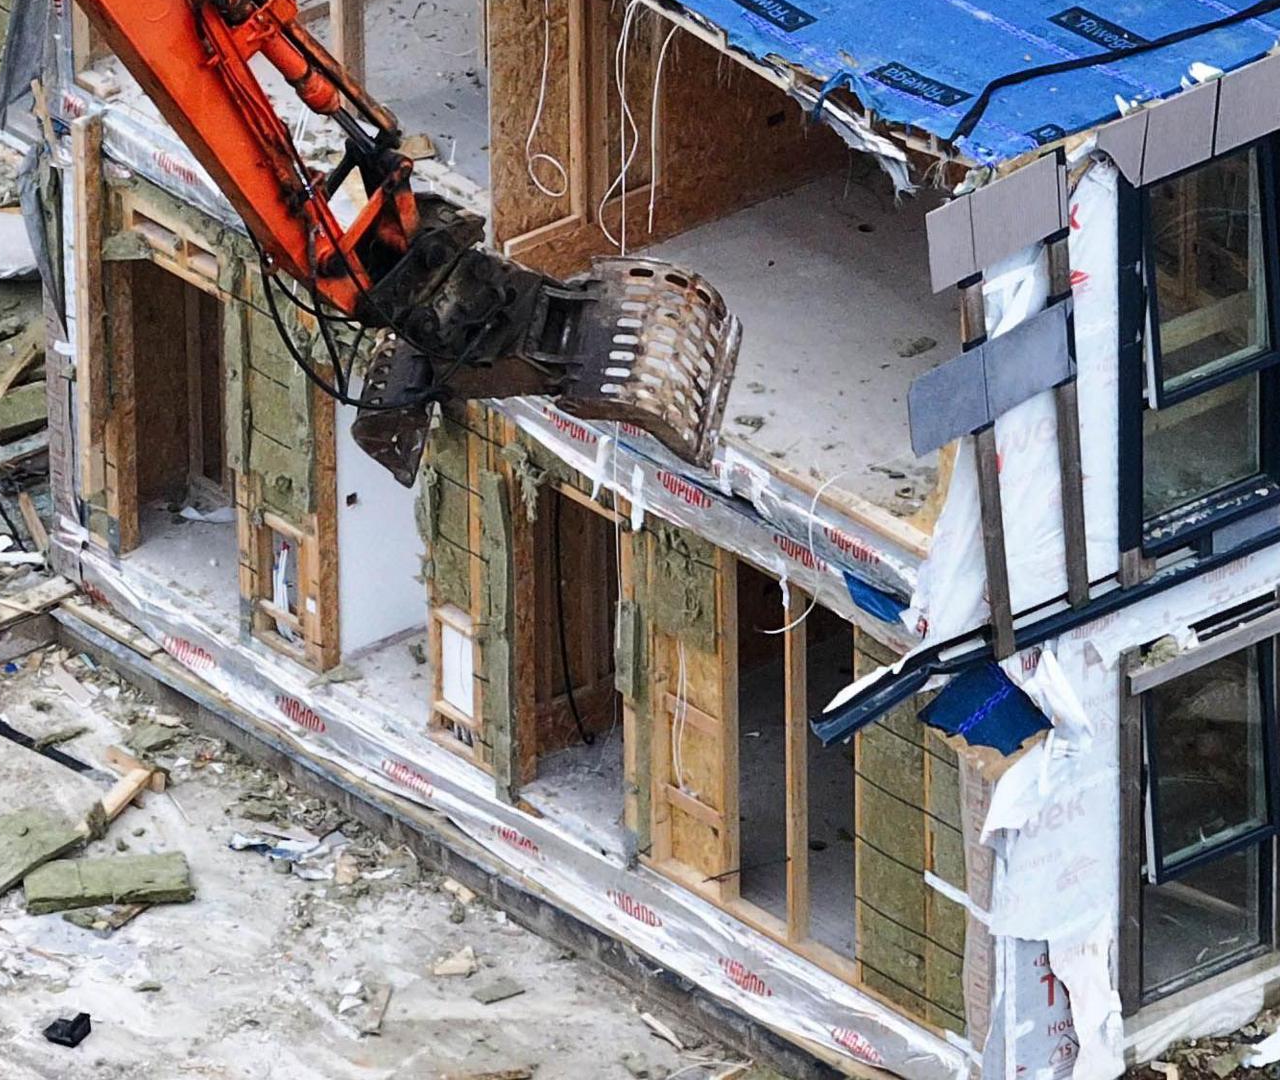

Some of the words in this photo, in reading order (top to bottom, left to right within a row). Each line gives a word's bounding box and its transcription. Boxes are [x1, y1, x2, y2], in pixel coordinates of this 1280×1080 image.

[1077, 17, 1137, 51] Riwega
[882, 66, 943, 99] Riwega
[663, 472, 708, 508] DUPONT
[830, 528, 874, 565] DUPONT
[612, 890, 657, 927] DUPONT
